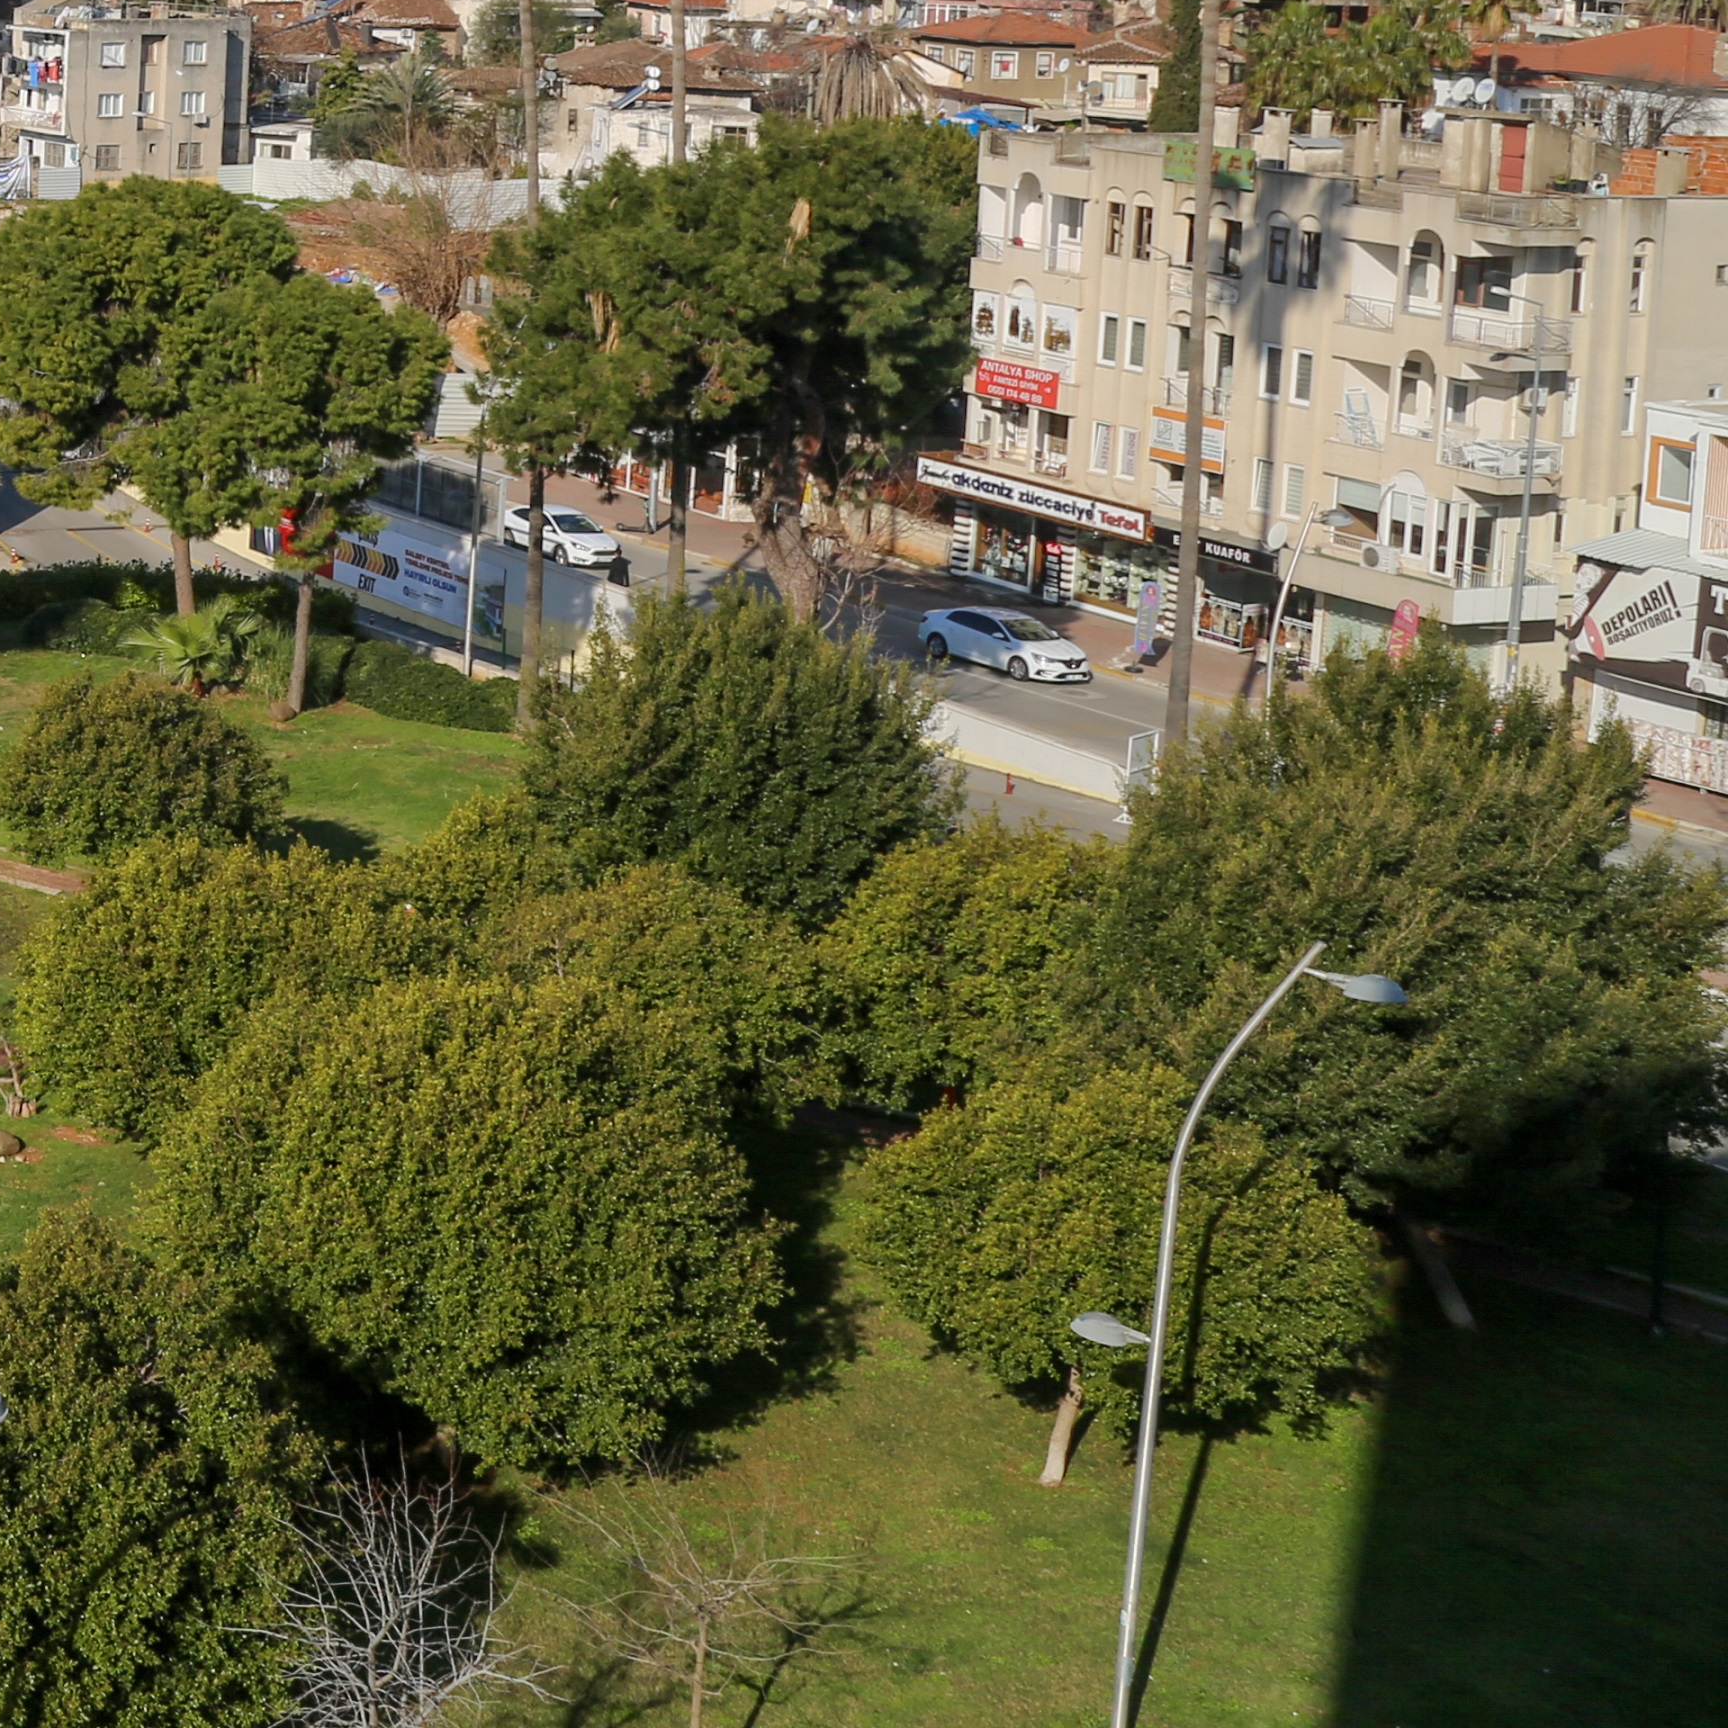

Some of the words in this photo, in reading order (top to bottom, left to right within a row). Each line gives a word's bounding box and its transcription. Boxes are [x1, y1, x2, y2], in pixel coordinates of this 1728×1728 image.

[981, 360, 1022, 377] ANTALYA
[1025, 369, 1053, 383] SHOP
[951, 472, 1014, 499] akdeniz
[1018, 490, 1094, 520] züccaciye
[1099, 511, 1141, 533] Tefal
[1205, 543, 1250, 563] KUAFÖR
[358, 574, 376, 594] EXIT
[404, 568, 432, 585] HAYIRLI
[433, 579, 457, 594] OLSUN
[1607, 608, 1674, 646] BOŞALTIYORUZ
